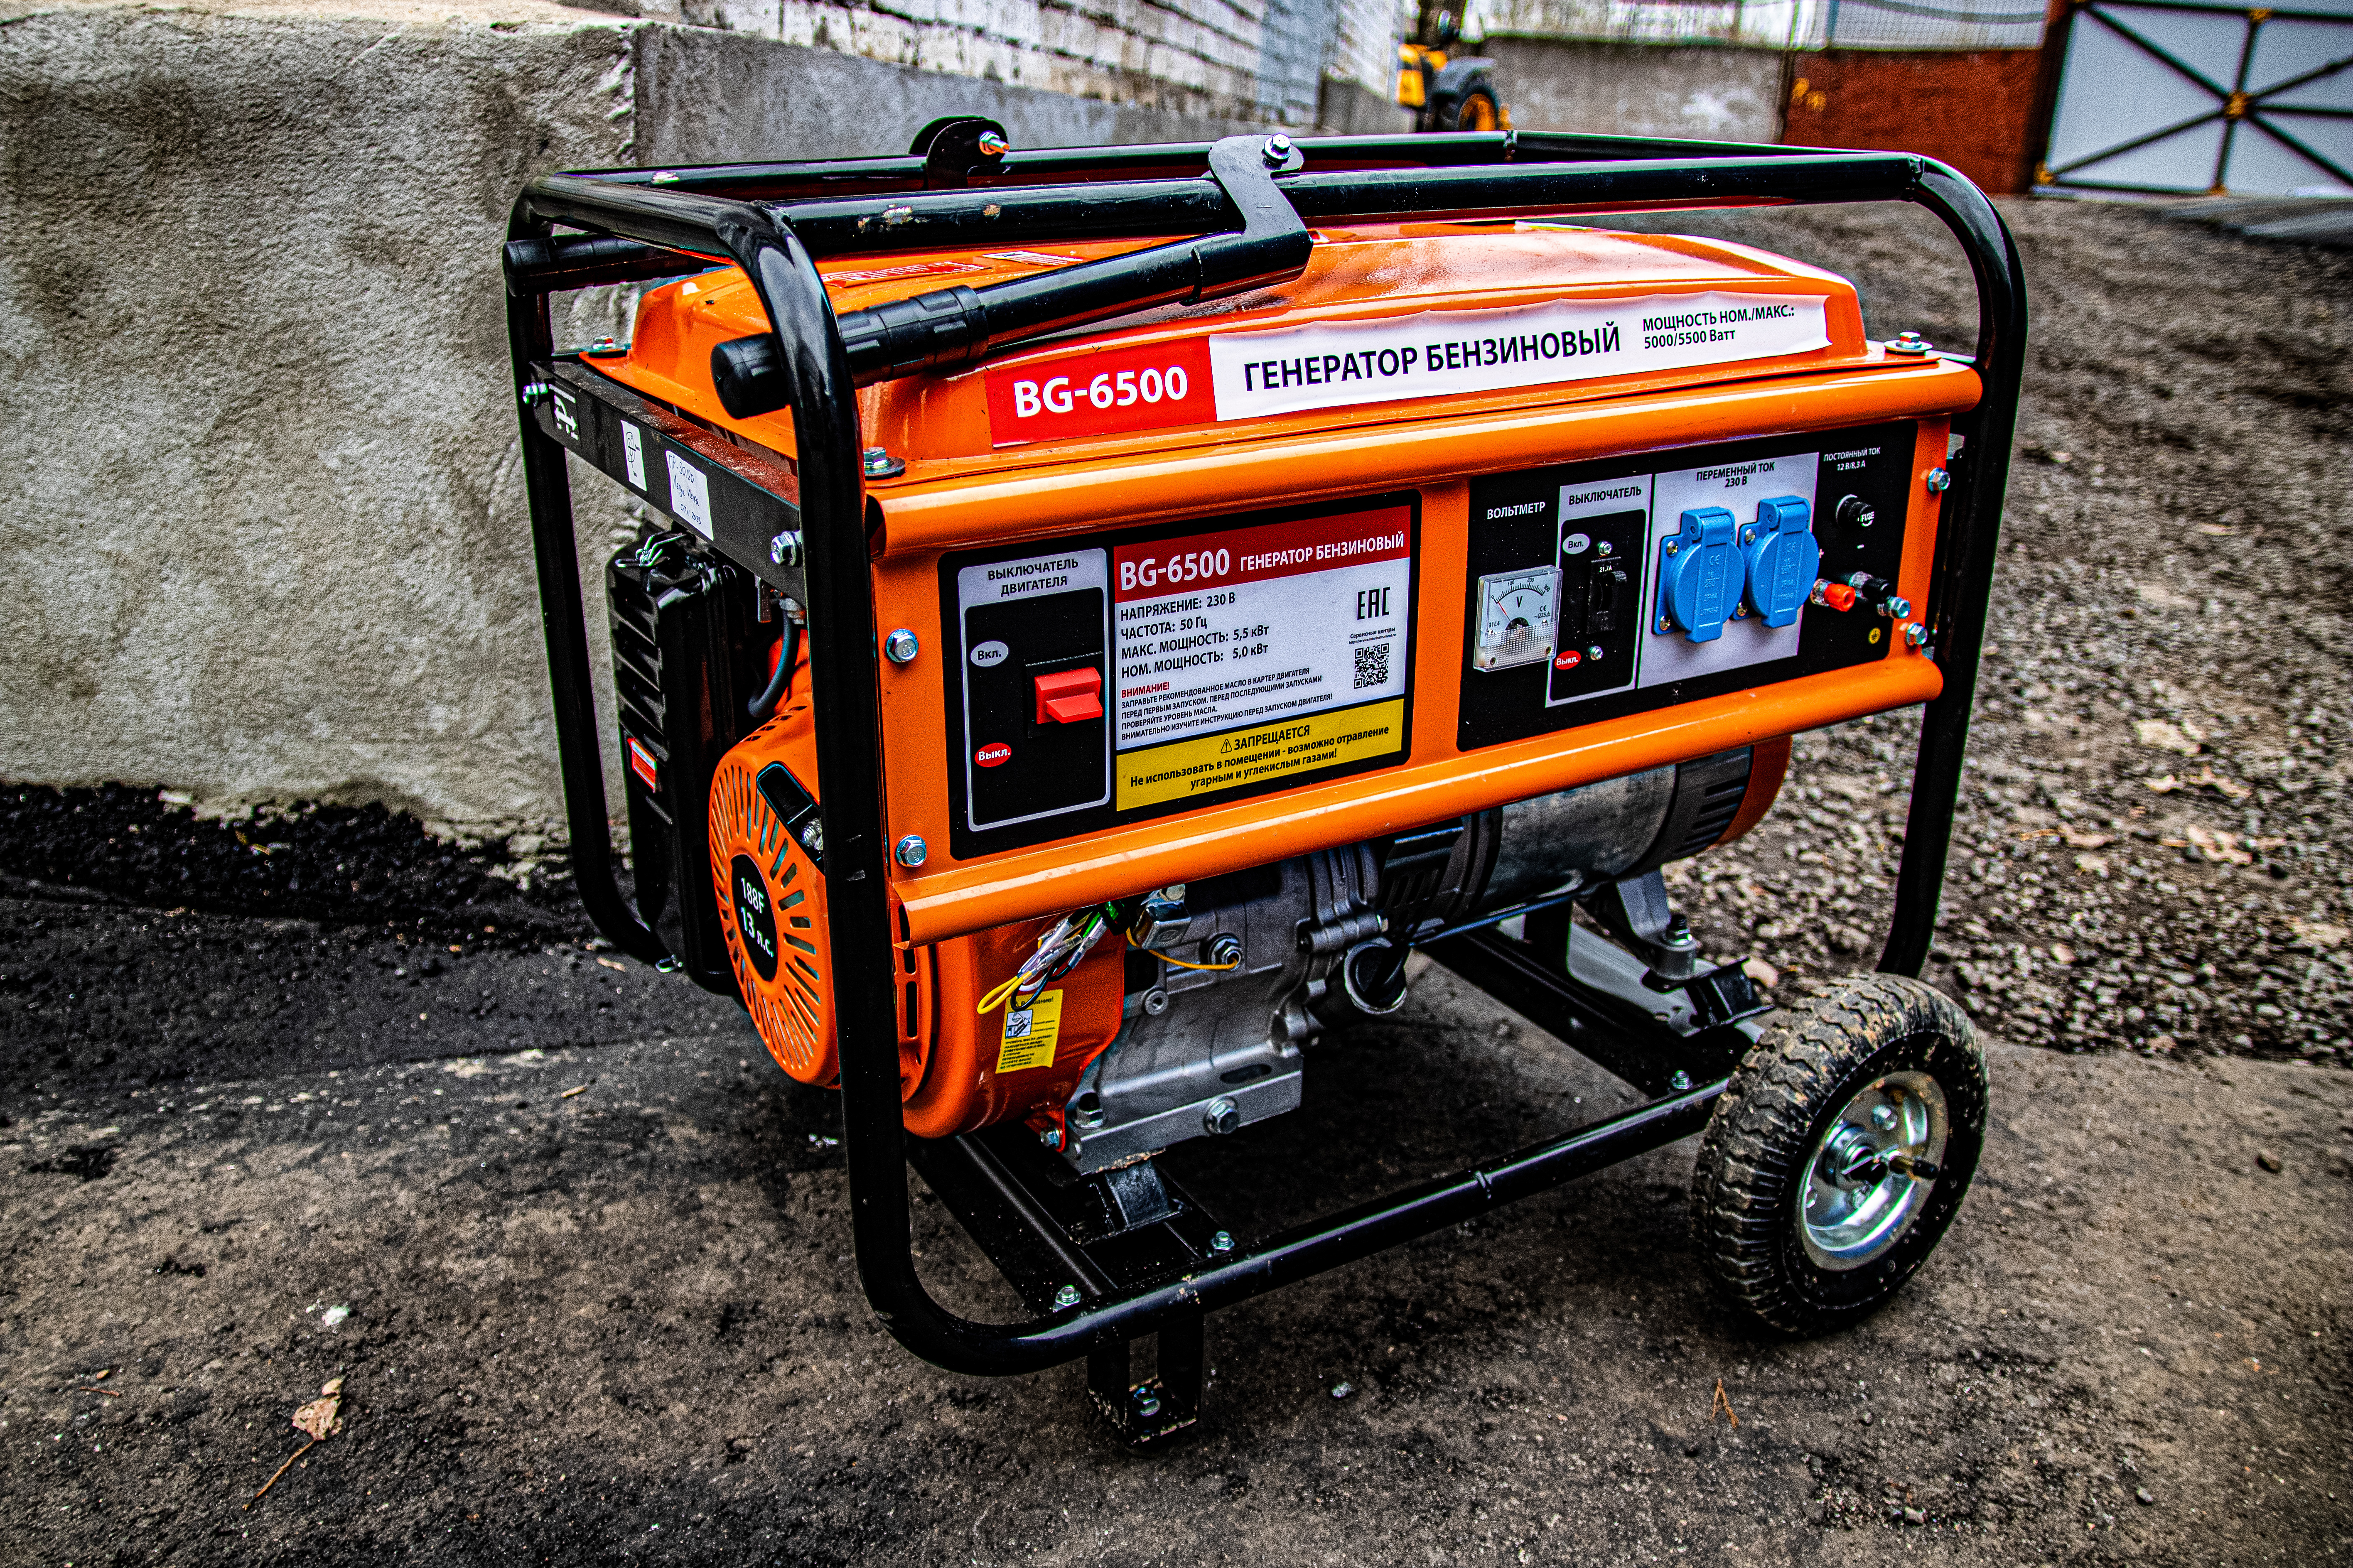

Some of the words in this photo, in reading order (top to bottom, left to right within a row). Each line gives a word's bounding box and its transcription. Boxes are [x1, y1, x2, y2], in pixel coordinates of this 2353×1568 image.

[1643, 312, 1717, 331] МОЩНОСТЬ
[1720, 304, 1795, 324] НОМ./МАКС.:
[1644, 331, 1706, 349] 5000/5500
[1710, 329, 1735, 342] Ватт
[1244, 346, 1418, 391] ГЕНЕРАТОР
[1426, 321, 1621, 372] БЕНЗИНОВЫЙ
[1014, 366, 1188, 417] BG-6500
[1823, 448, 1867, 461] ПОСТОЯННЫЙ
[1869, 447, 1880, 455] ТОК
[1696, 462, 1756, 481] ПЕРЕМЕННЫЙ
[1758, 461, 1775, 472] ТОК
[1725, 477, 1740, 487] 230
[1742, 476, 1748, 485] В
[1569, 486, 1642, 505] ВЫКЛЮЧАТЕЛЬ
[1487, 502, 1545, 519] ВОЛЬТМЕТР
[1860, 511, 1874, 522] FUSE
[1240, 547, 1313, 572] ГЕНЕРАТОР
[1316, 531, 1404, 560] БЕНЗИНОВЫЙ
[1568, 540, 1584, 549] Вкл.
[988, 558, 1078, 581] ВЫКЛЮЧАТЕЛЬ
[1121, 548, 1230, 591] BG-6500
[1000, 576, 1067, 597] ДВИГАТЕЛЯ
[1121, 597, 1202, 621] НАПРЯЖЕНИЕ:
[1206, 594, 1226, 607] 230
[1228, 592, 1235, 604] В
[1516, 596, 1523, 608] V
[1121, 621, 1175, 640] ЧАСТОТА:
[1180, 618, 1193, 631] 50
[1196, 616, 1207, 628] Гц
[1350, 631, 1377, 639] Сервисные
[1121, 643, 1157, 660] МАКС.
[1159, 632, 1228, 653] МОЩНОСТЬ:
[1233, 628, 1248, 641] 5,5
[1251, 625, 1269, 637] кВт
[978, 650, 1002, 660] Вкл.
[1121, 663, 1152, 678] НОМ.
[1154, 651, 1223, 673] МОЩНОСТЬ:
[1233, 646, 1247, 660] 5,0
[1250, 643, 1268, 655] кВт
[1556, 657, 1578, 666] Выкл.
[1121, 681, 1169, 698] ВНИМАНИЕ!
[1122, 695, 1157, 709] ЗАПРАВЬТЕ
[1159, 683, 1223, 702] РЕКОМЕНДОВАННОЕ
[1224, 679, 1246, 690] МАСЛО
[1253, 674, 1275, 684] КАРТЕР
[1276, 667, 1310, 681] ДВИГАТЕЛЯ
[1122, 709, 1142, 719] ПЕРЕД
[1144, 704, 1171, 715] ПЕРВЫМ
[1172, 697, 1208, 709] ЗАПУСКОМ.
[1209, 692, 1229, 703] ПЕРЕД
[1231, 682, 1285, 699] ПОСЛЕДУЮЩИМИ
[1286, 675, 1322, 688] ЗАПУСКАМИ
[1122, 725, 1170, 740] ВНИМАТЕЛЬНО
[1171, 719, 1199, 731] ИЗУЧИТЕ
[1200, 710, 1243, 725] ИНСТРУКЦИЮ
[1244, 707, 1263, 717] ПЕРЕД
[1265, 700, 1297, 713] ЗАПУСКОМ
[1298, 693, 1332, 707] ДВИГАТЕЛЯ!
[1122, 716, 1162, 730] ПРОВЕРЯЙТЕ
[1164, 710, 1192, 722] УРОВЕНЬ
[1194, 706, 1218, 716] МАСЛА.
[1234, 725, 1310, 750] ЗАПРЕЩАЕТСЯ
[978, 749, 1010, 761] Выкл.
[1130, 775, 1143, 787] Не
[1146, 763, 1214, 784] использовать
[1216, 761, 1222, 769] в
[1224, 748, 1280, 768] помещении
[1288, 738, 1334, 754] возможно
[1337, 726, 1389, 744] отравление
[1191, 772, 1233, 791] угарным
[1244, 758, 1300, 779] углекислым
[1302, 748, 1337, 764] газами!
[741, 877, 765, 914] 188F
[741, 906, 756, 938] 13
[757, 930, 774, 958] л.с.
